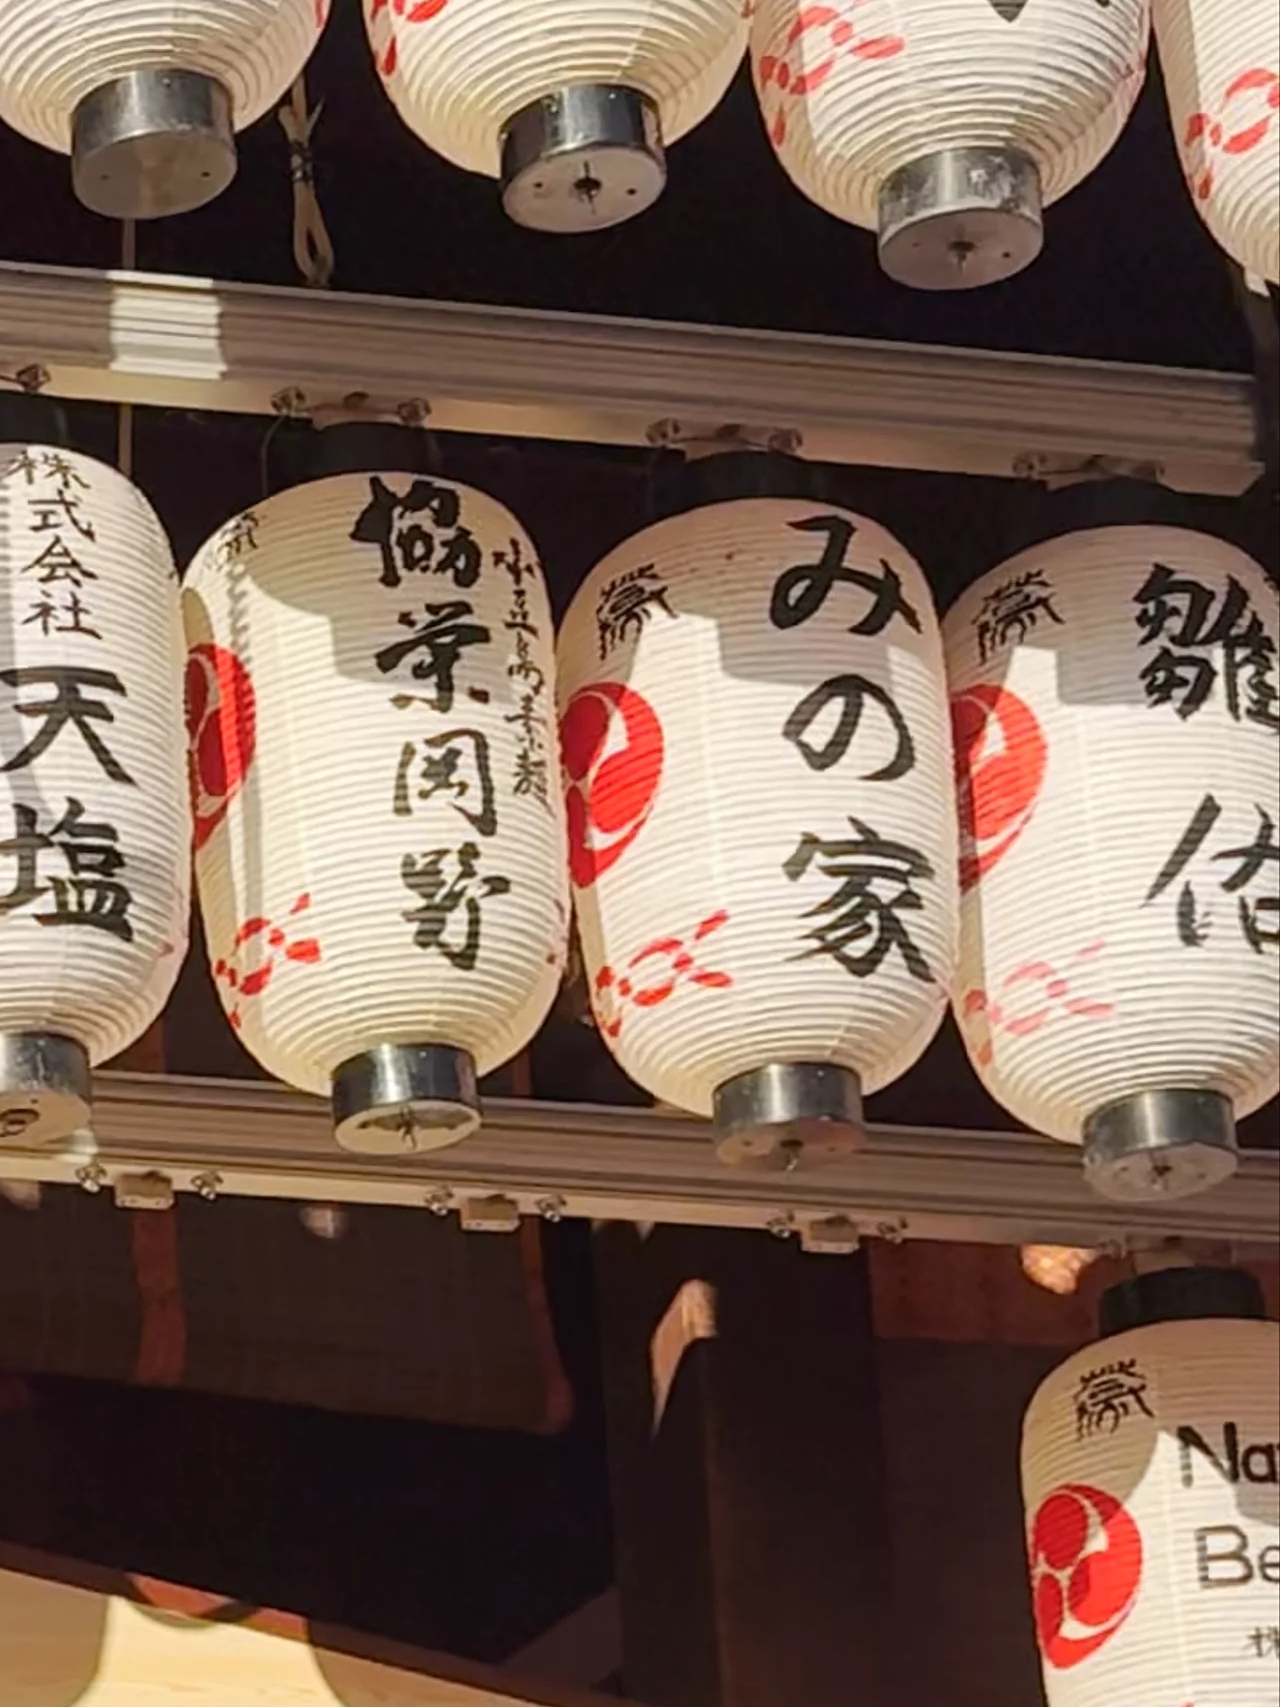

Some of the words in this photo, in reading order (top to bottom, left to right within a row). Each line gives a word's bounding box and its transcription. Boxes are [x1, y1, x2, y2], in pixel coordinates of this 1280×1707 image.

[7, 447, 104, 640] 株式会社
[770, 514, 935, 983] みの家
